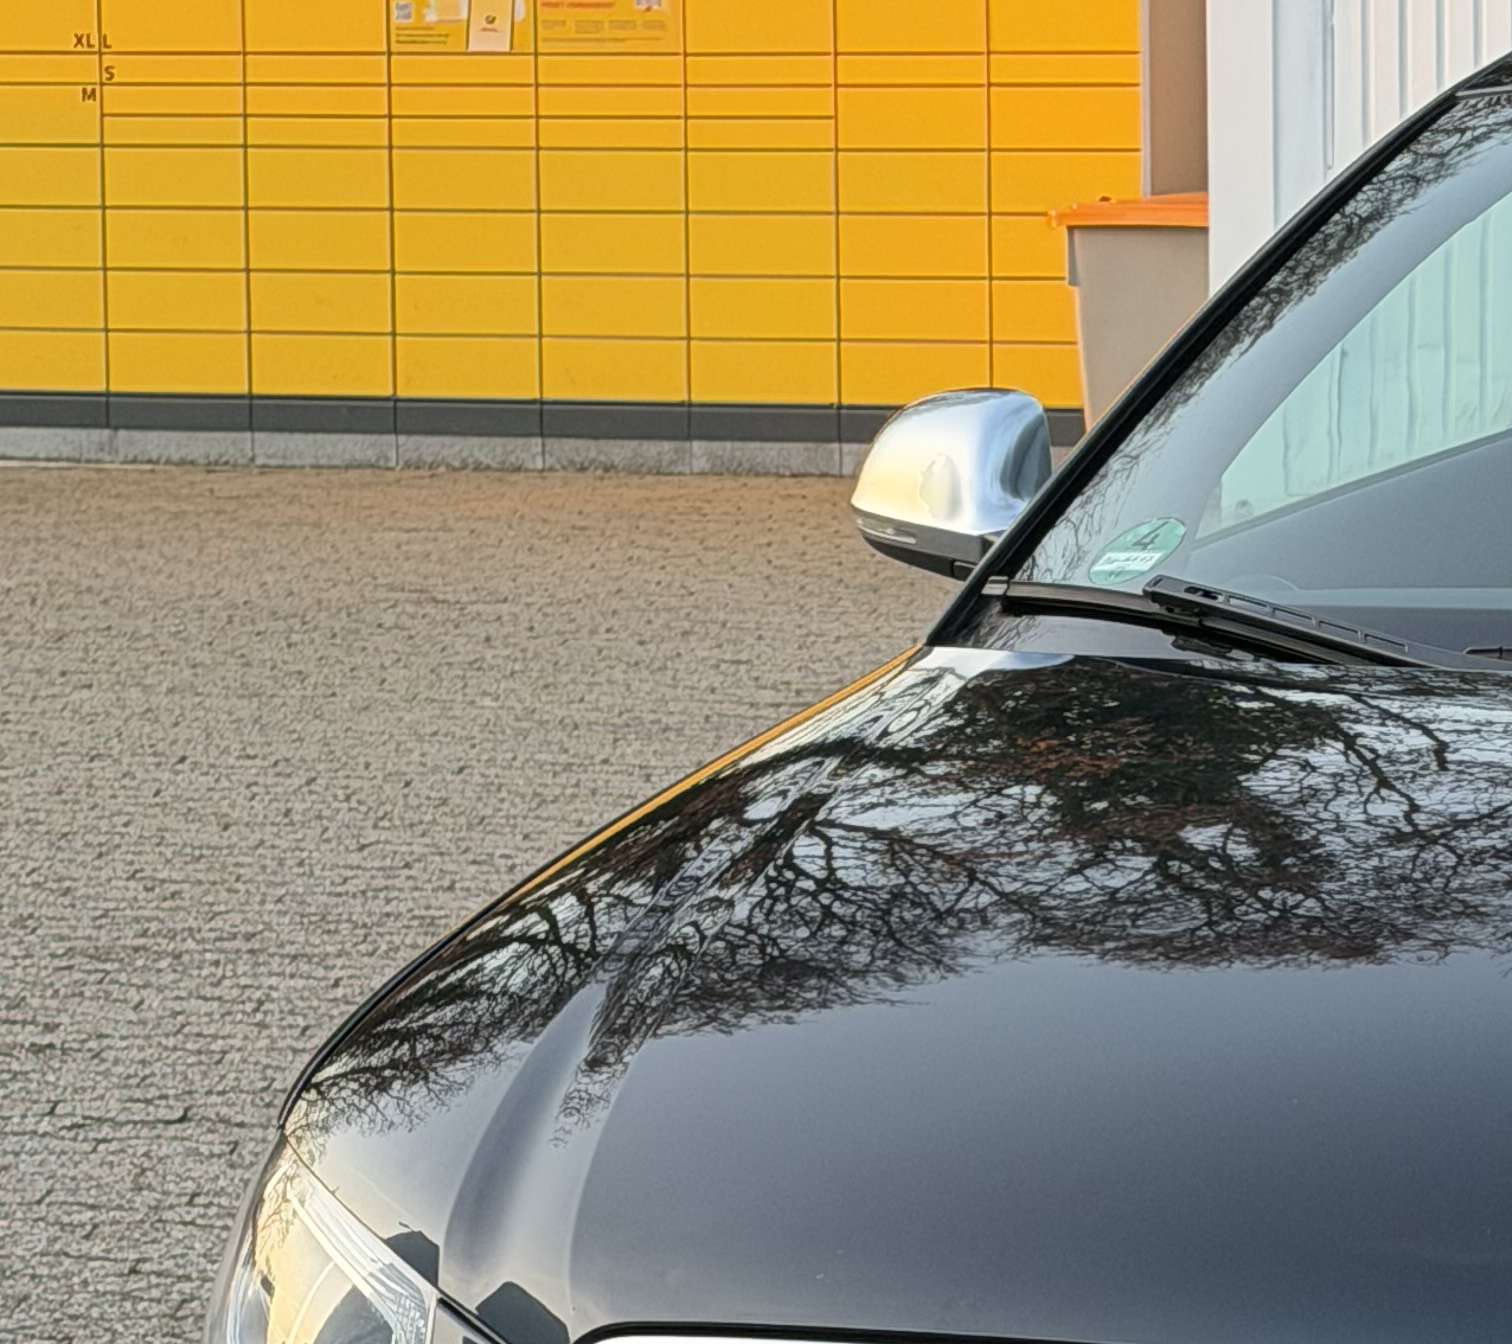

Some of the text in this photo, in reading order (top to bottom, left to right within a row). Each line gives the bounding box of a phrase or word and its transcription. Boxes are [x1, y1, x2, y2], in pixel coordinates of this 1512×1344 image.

[73, 32, 96, 49] XL
[102, 33, 113, 49] L
[104, 65, 115, 82] S
[81, 87, 97, 102] M
[1131, 521, 1170, 551] 4
